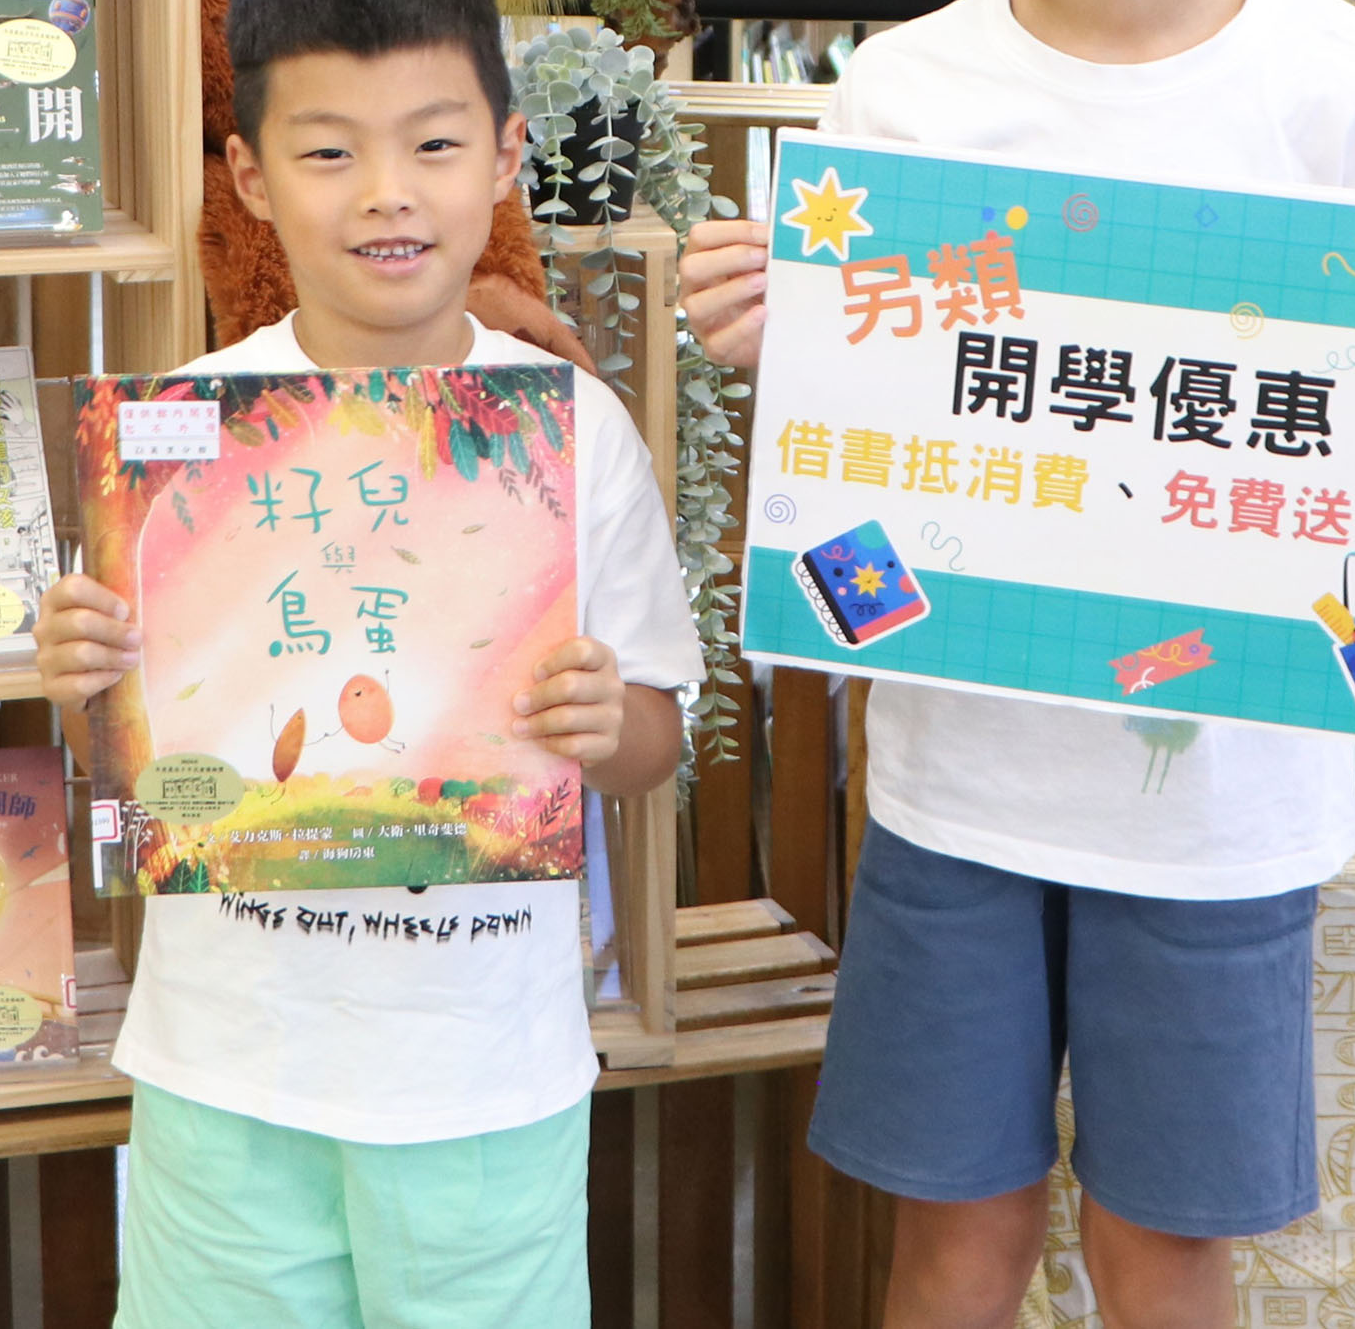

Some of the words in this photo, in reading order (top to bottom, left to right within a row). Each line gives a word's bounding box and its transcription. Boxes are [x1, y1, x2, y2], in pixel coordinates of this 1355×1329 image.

[26, 86, 83, 143] 開
[839, 231, 1027, 345] 另類
[951, 331, 1337, 458] 開學優惠
[246, 459, 410, 533] 籽兒
[266, 570, 410, 658] 鳥蛋
